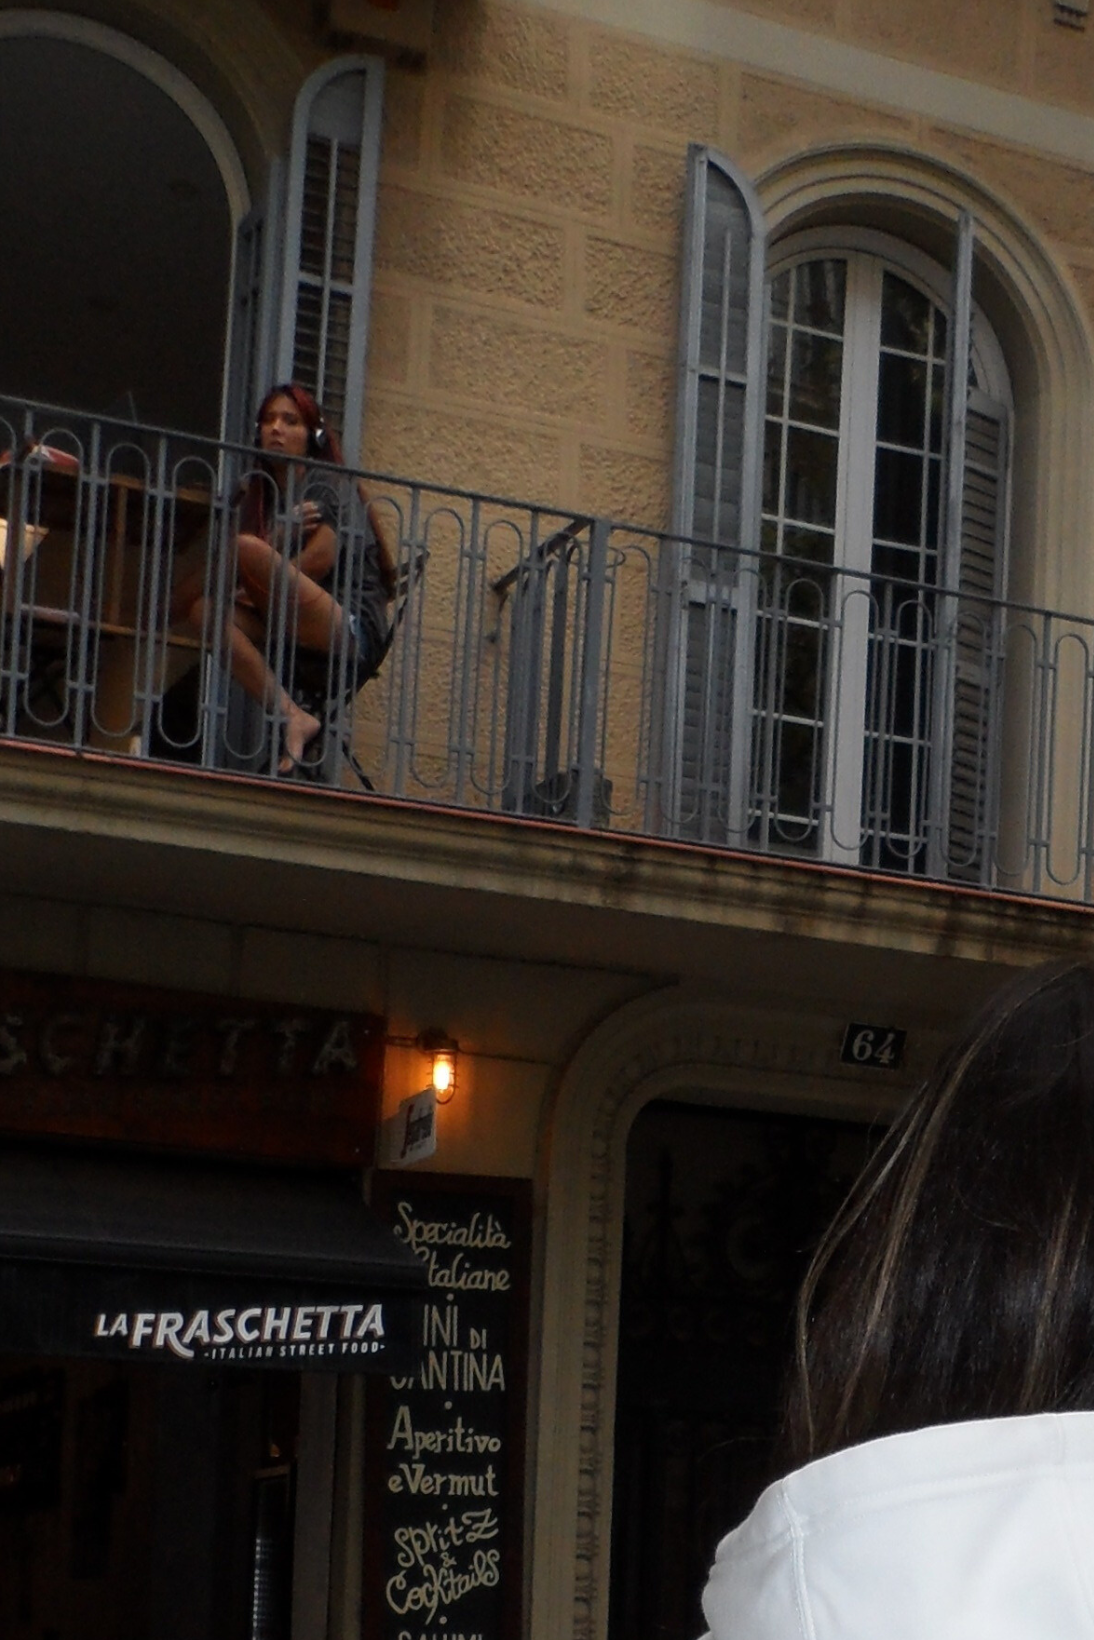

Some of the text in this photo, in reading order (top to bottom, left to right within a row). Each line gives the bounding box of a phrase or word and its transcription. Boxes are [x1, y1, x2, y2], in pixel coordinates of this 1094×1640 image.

[852, 1029, 896, 1064] 64
[393, 1202, 511, 1251] Specialità
[95, 1303, 385, 1359] LA FRASCHETTA
[279, 1343, 335, 1357] STREET
[469, 1327, 487, 1349] DI
[386, 1405, 501, 1460] Aperitivo
